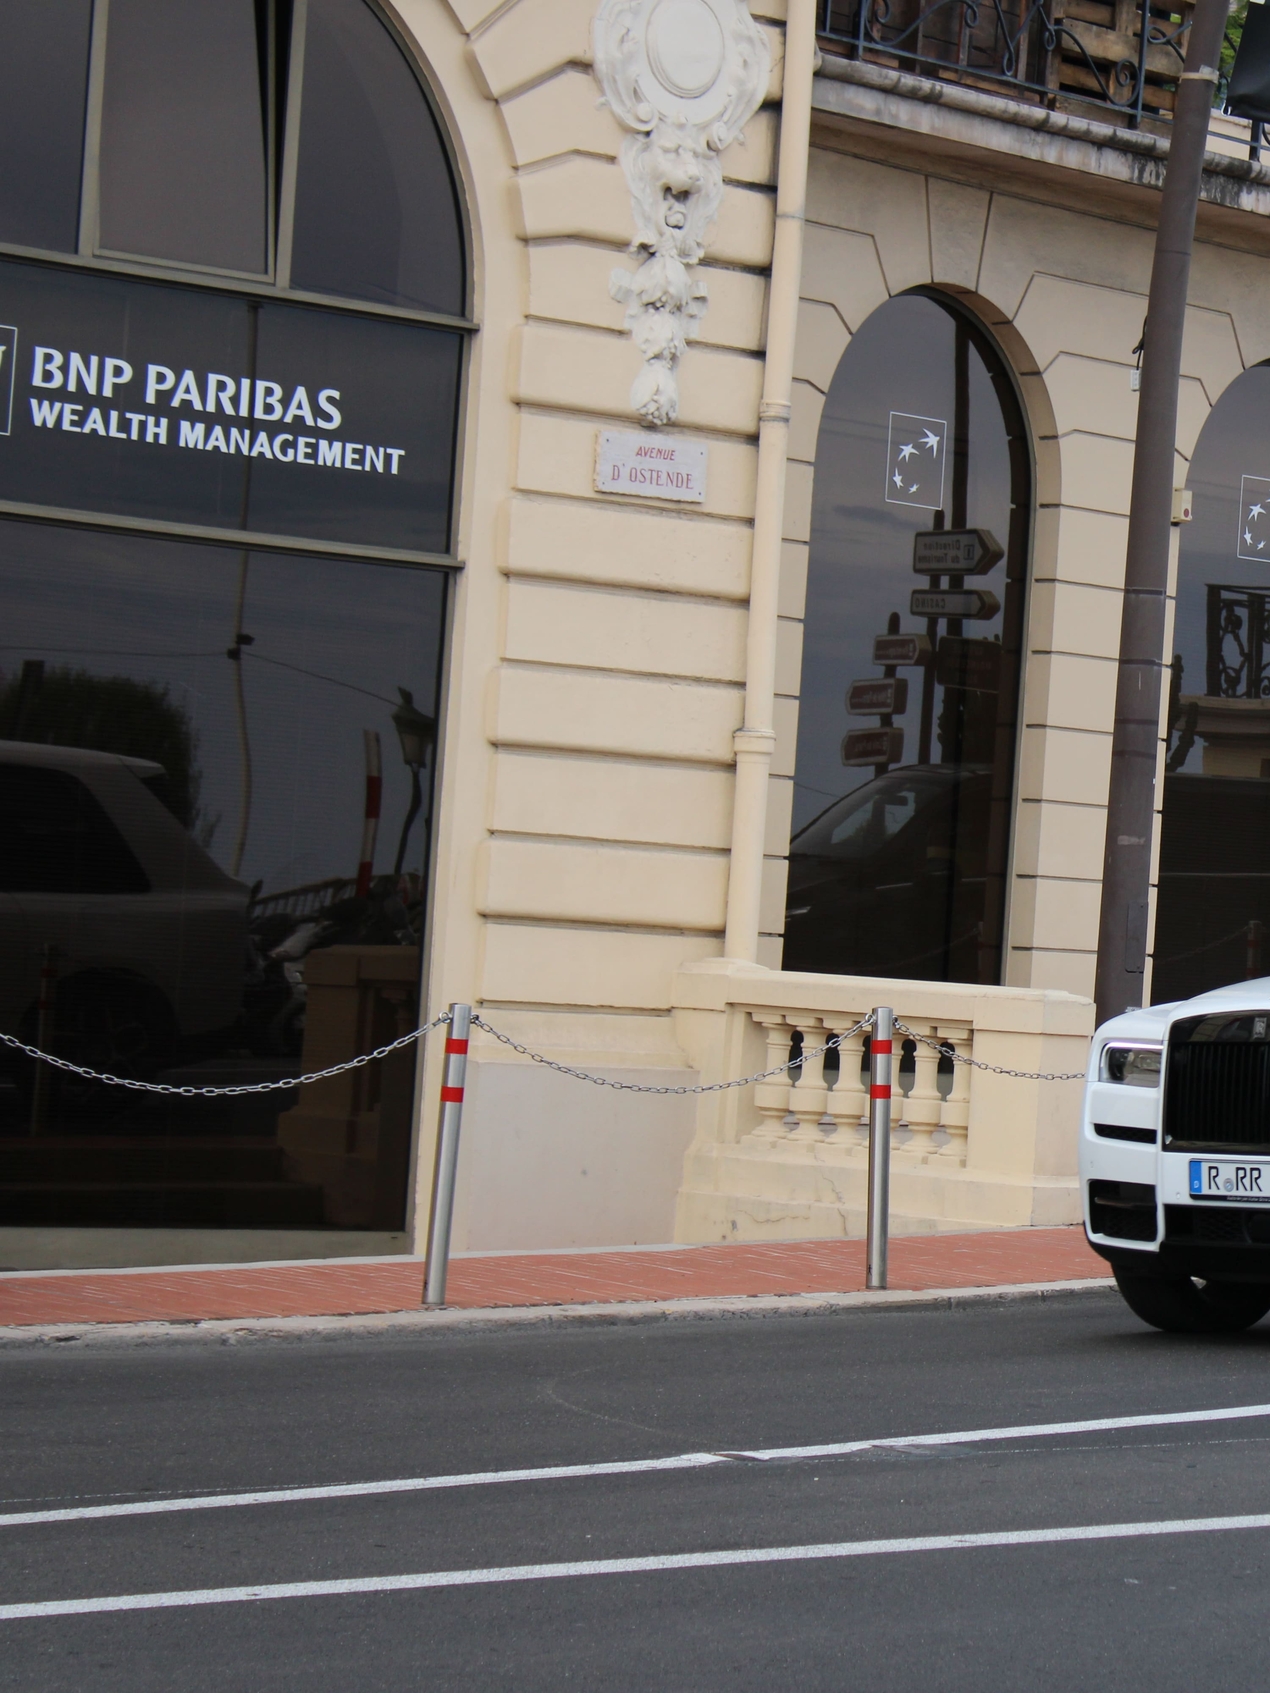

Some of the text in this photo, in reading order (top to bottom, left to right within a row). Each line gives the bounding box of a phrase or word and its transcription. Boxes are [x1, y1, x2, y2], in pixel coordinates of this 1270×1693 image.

[31, 345, 343, 431] BNP PARIBAS
[29, 397, 406, 475] WEALTH MANAGEMENT
[635, 446, 676, 461] AVENUE
[1208, 1166, 1220, 1190] R
[1235, 1167, 1262, 1192] RR
